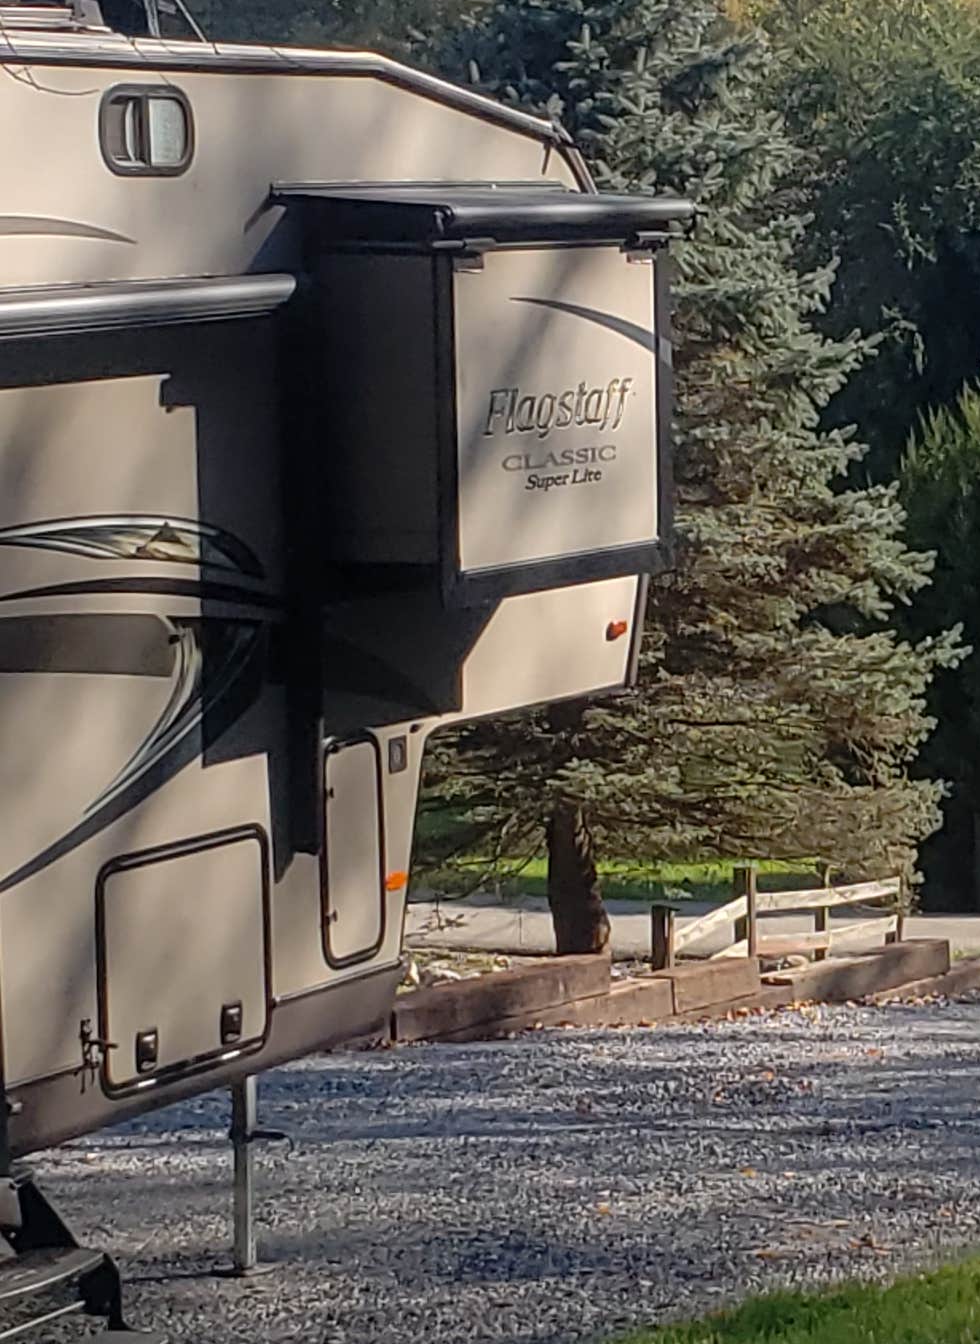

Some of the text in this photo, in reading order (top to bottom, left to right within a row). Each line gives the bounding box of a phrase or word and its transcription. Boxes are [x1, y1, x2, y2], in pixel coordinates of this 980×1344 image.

[483, 377, 633, 438] Flagstaff
[502, 446, 616, 471] CLASSIC
[525, 469, 602, 491] Super Lite
